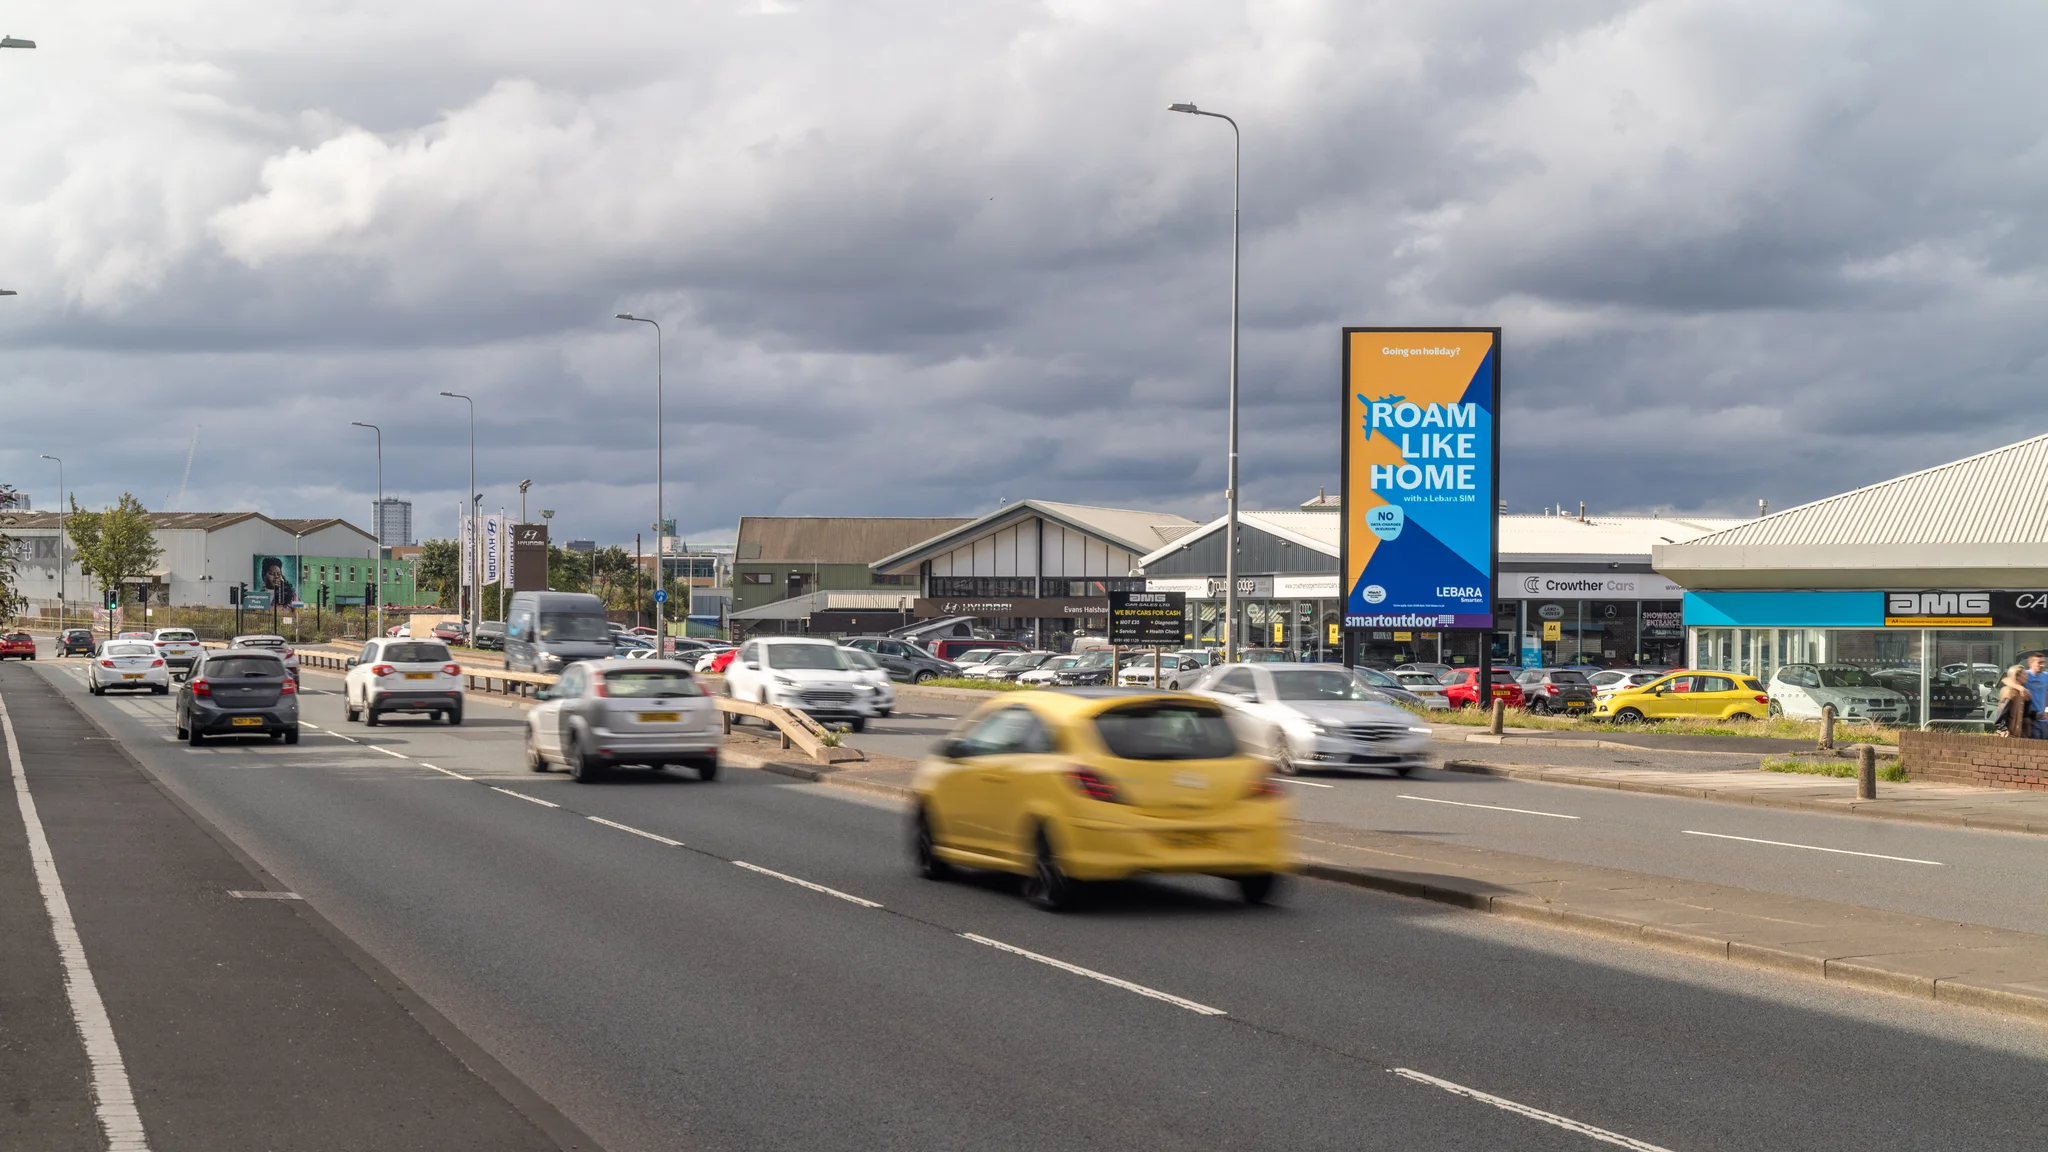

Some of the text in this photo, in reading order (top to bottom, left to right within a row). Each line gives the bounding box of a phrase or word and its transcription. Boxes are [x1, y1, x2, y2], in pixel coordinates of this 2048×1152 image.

[1382, 347, 1409, 358] Going
[1423, 347, 1461, 358] holiday?
[1372, 402, 1476, 428] ROAM
[1402, 433, 1476, 458] LIKE
[1370, 464, 1476, 490] HOME
[1403, 494, 1422, 502] with
[1430, 494, 1458, 502] Lebara
[1459, 494, 1476, 502] SIM
[1378, 511, 1394, 521] NO
[488, 538, 496, 581] HYUNDAI
[1545, 580, 1635, 591] Crowther Cars
[1436, 586, 1483, 598] LEBARA
[962, 603, 1012, 611] HYUNDAI
[1345, 613, 1438, 627] smartoutdoor
